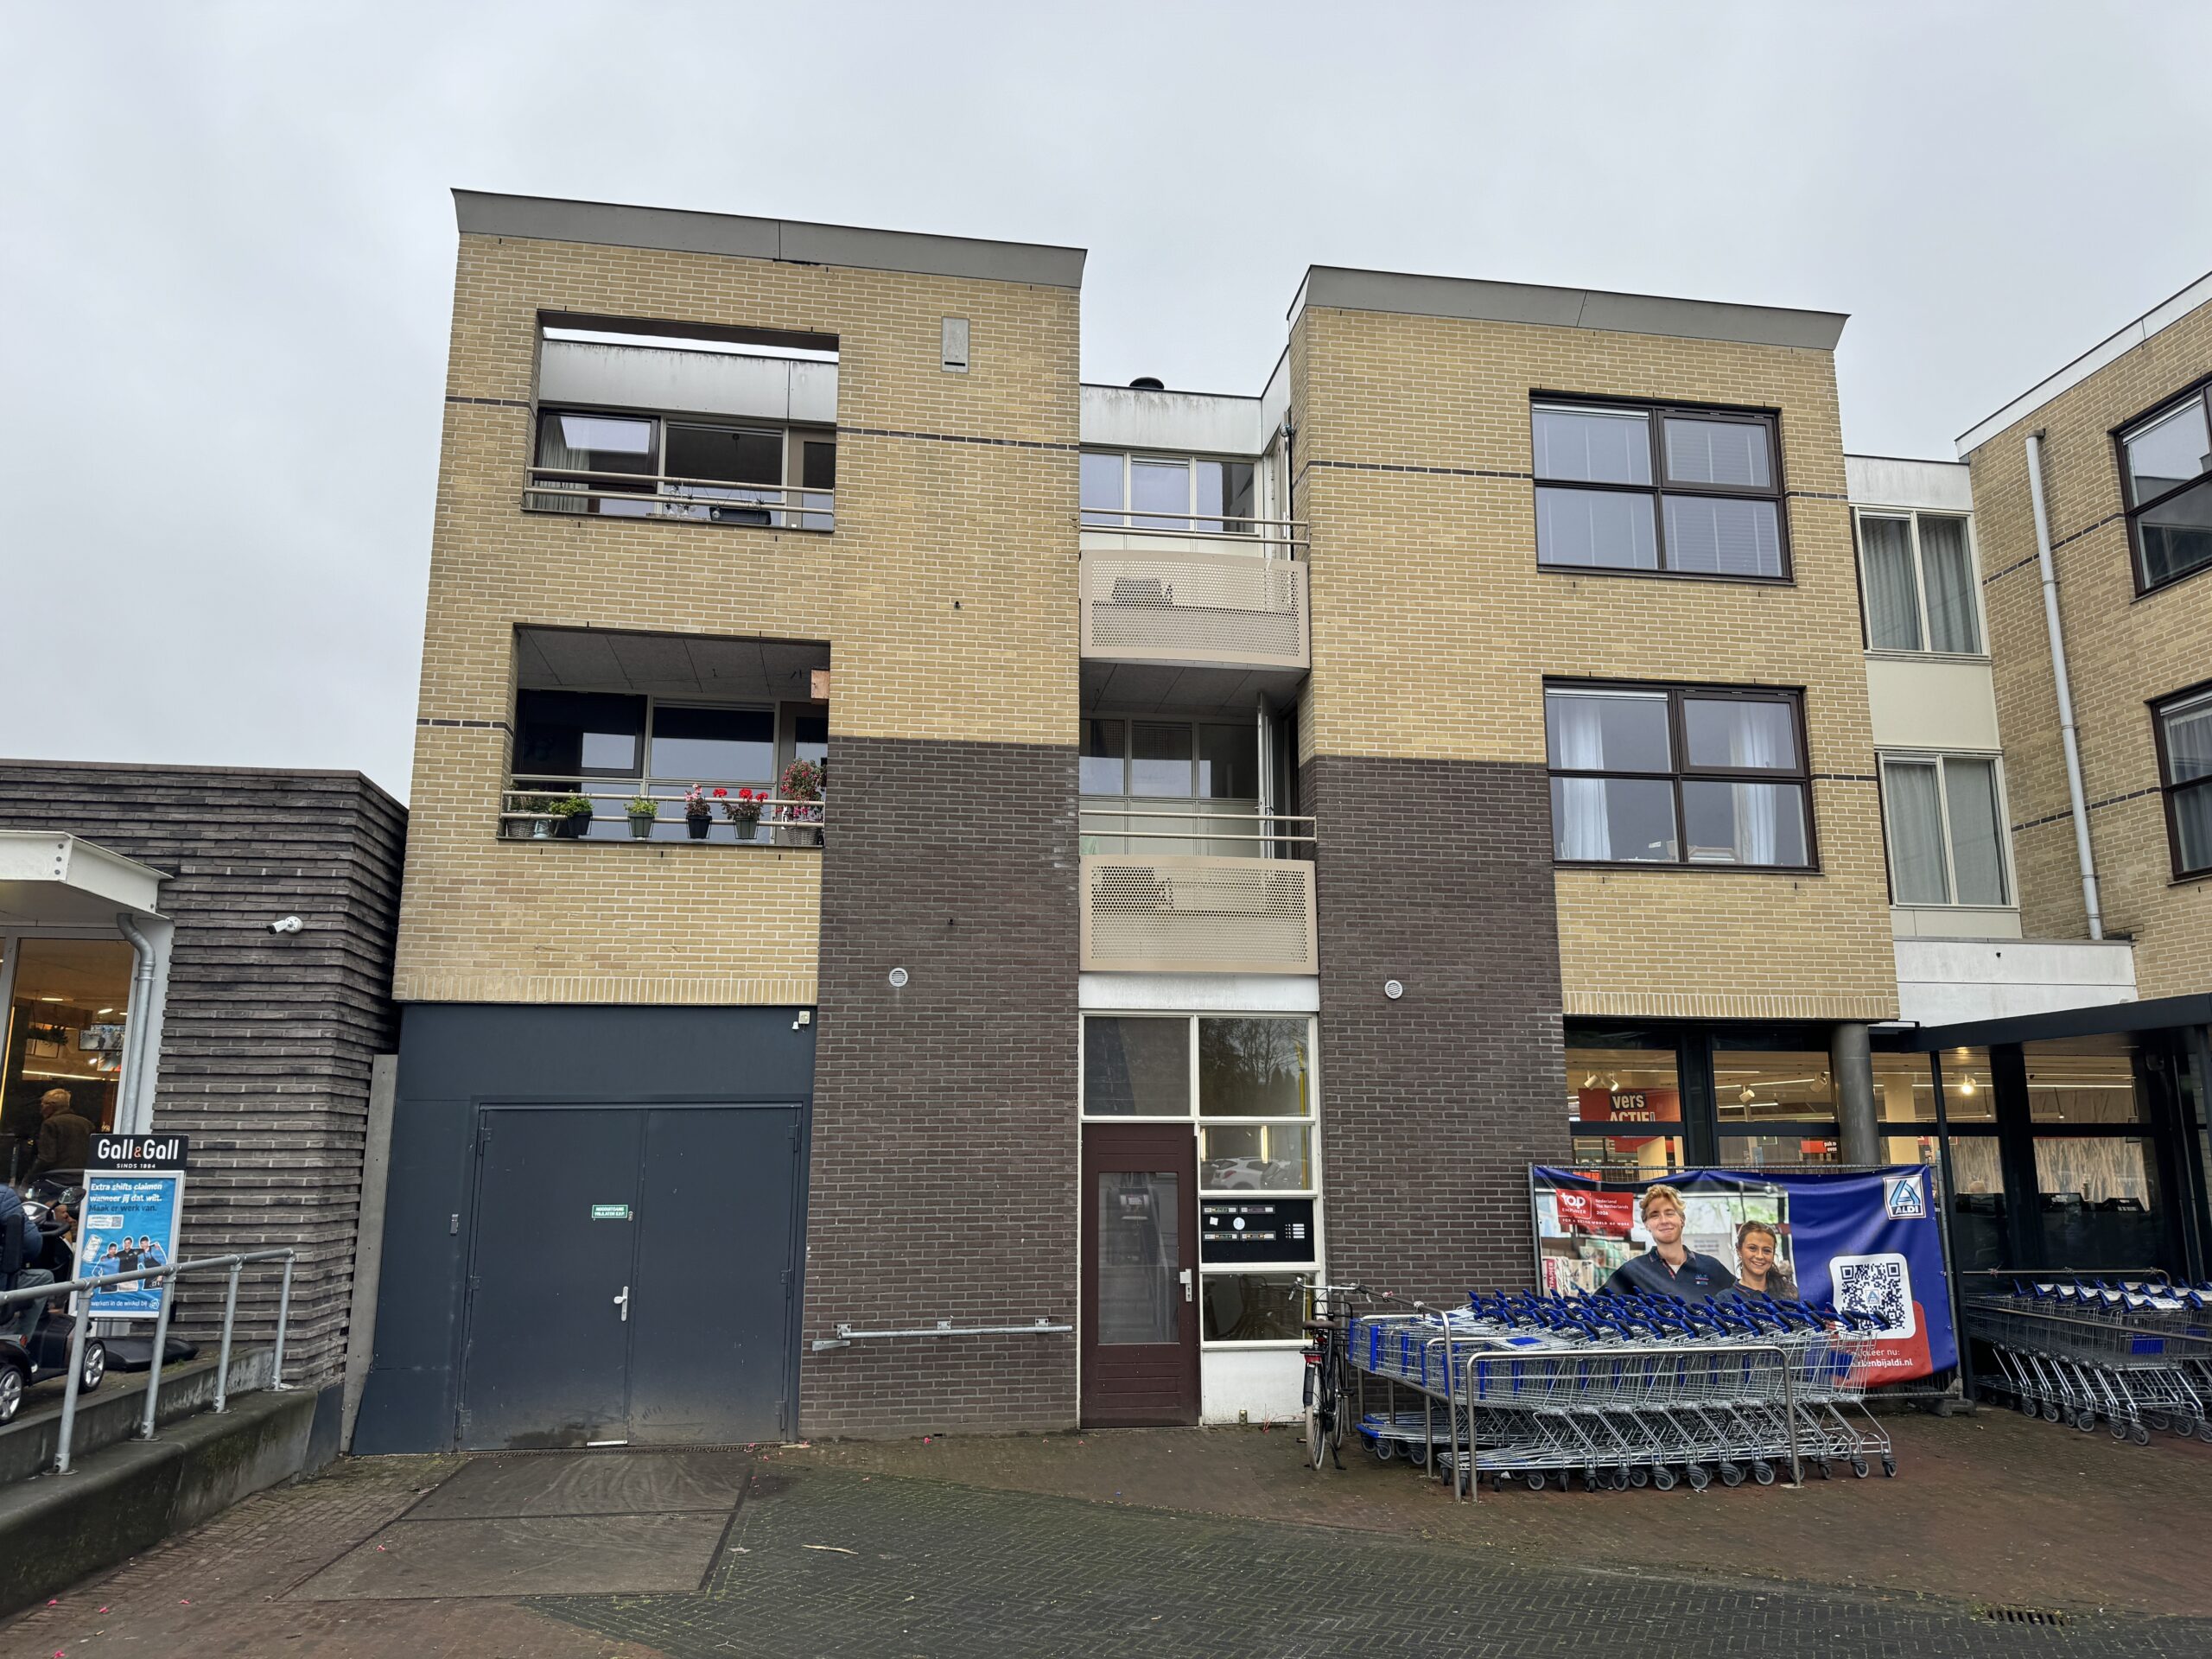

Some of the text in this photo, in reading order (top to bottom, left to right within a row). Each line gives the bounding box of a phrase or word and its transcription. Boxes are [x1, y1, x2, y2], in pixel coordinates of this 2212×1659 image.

[1612, 1094, 1644, 1109] vers
[122, 1194, 130, 1203] jij
[1560, 1192, 1586, 1210] top
